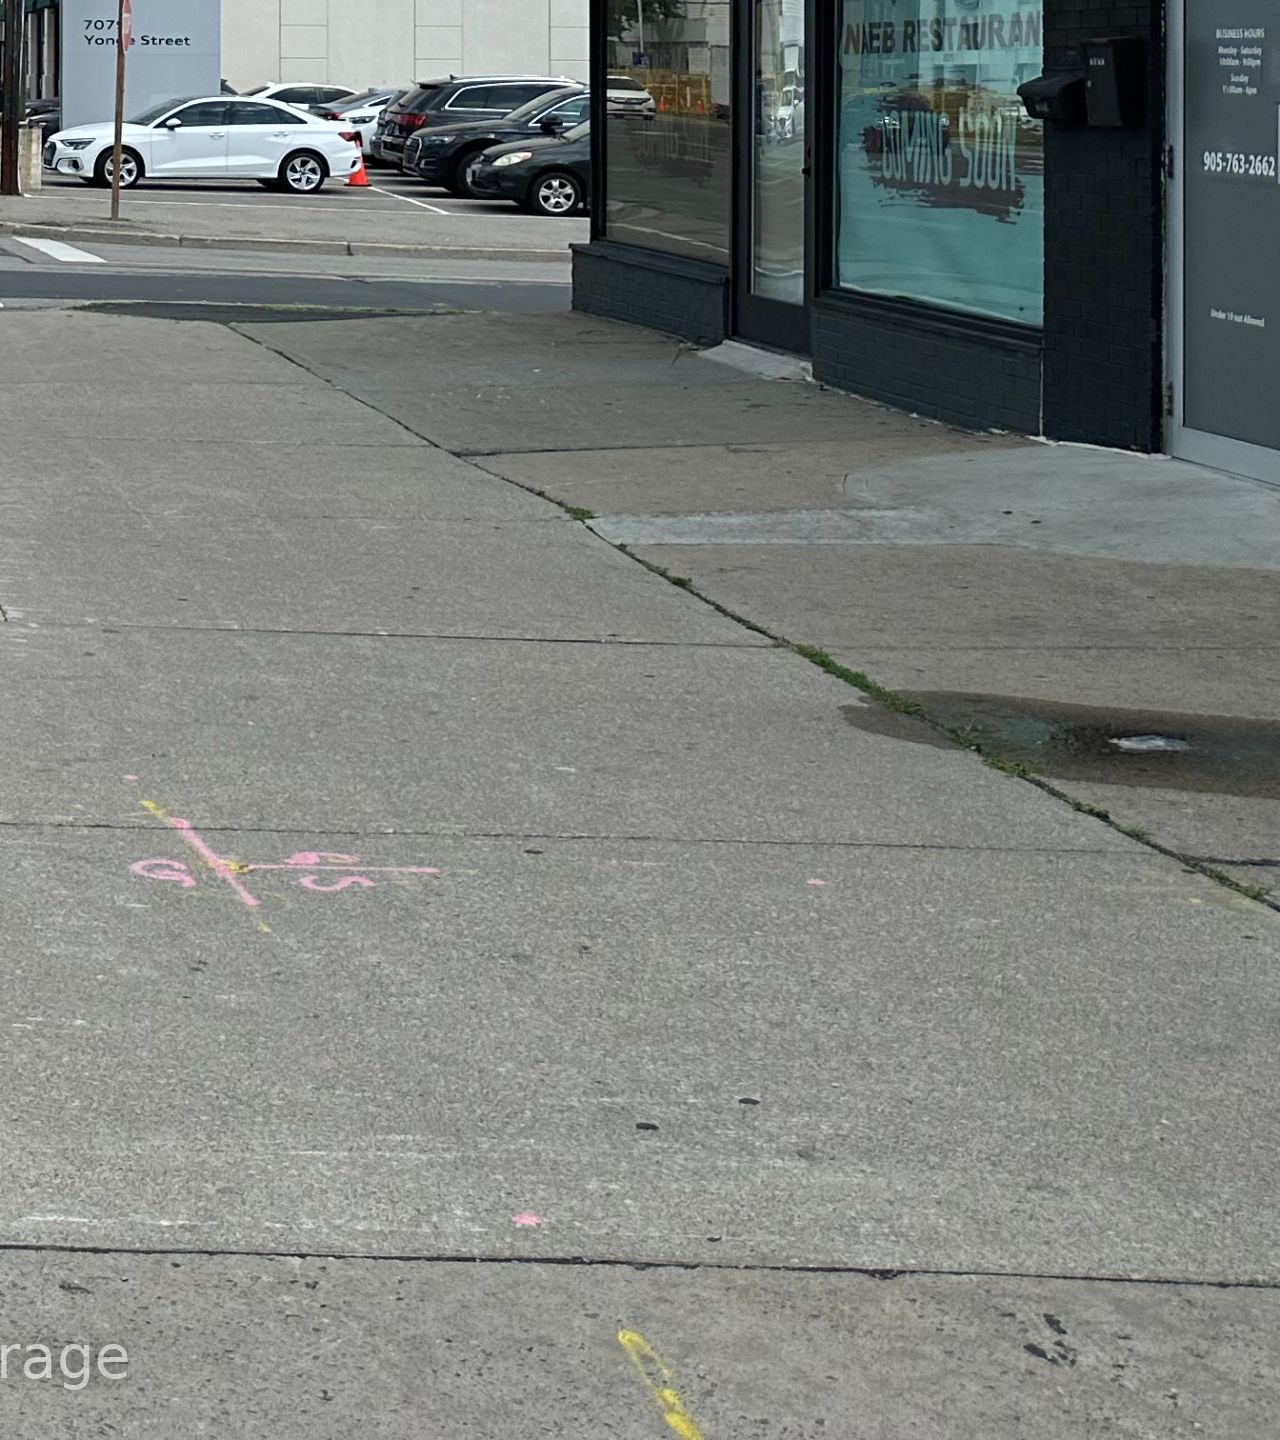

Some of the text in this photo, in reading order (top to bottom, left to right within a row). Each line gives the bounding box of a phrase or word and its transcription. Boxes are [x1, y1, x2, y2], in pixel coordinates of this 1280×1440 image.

[84, 19, 120, 31] 707
[843, 21, 896, 55] NAEB
[84, 34, 191, 47] Yone Street
[882, 106, 1017, 192] COMING SOON
[1203, 150, 1276, 177] 905-763-2662
